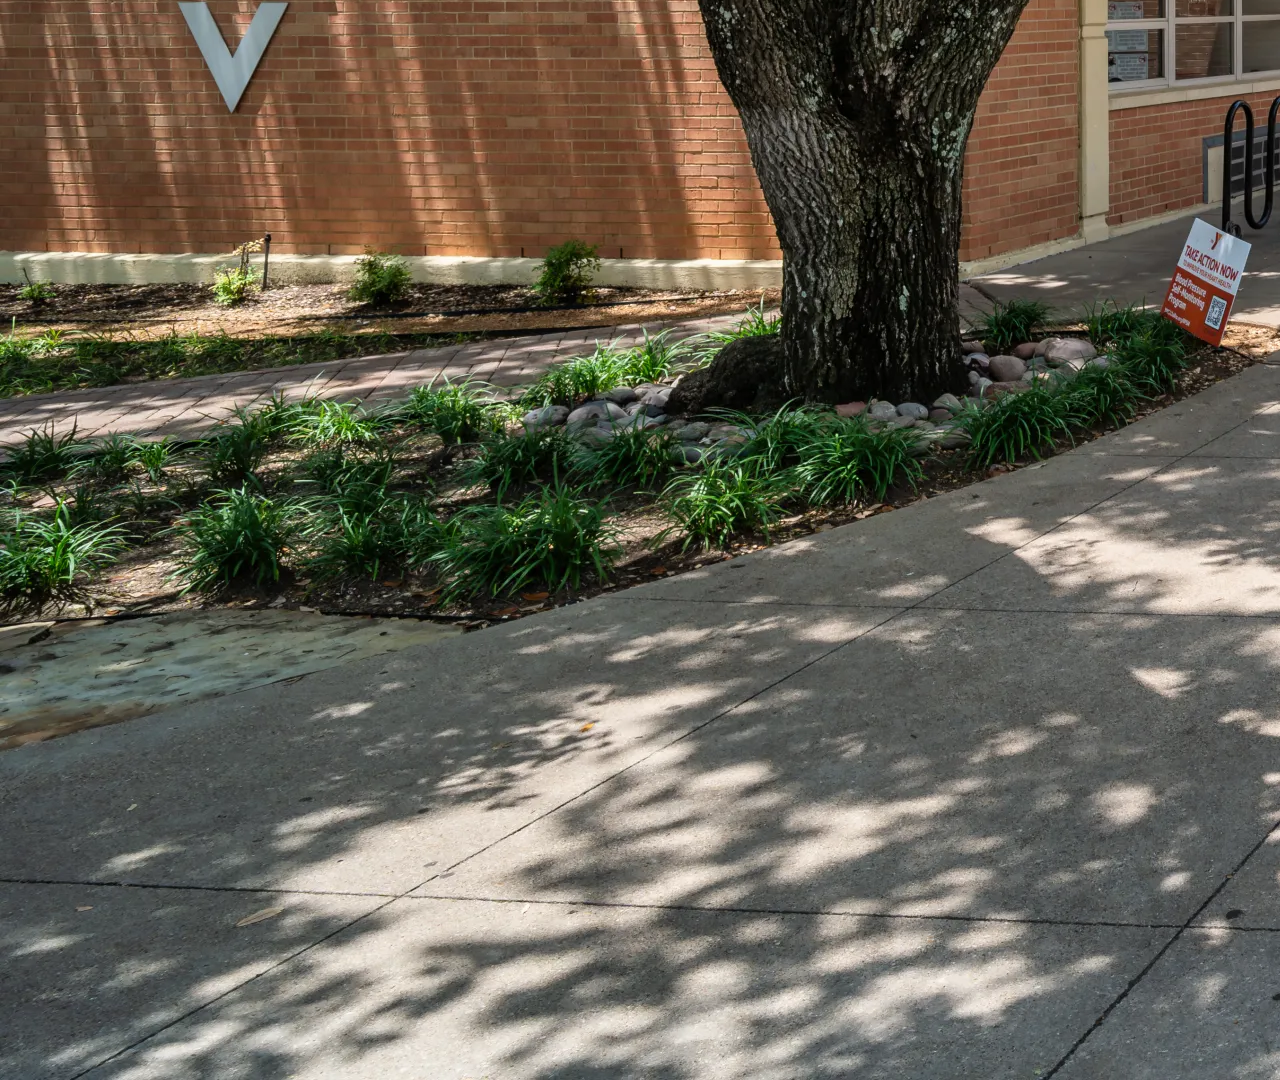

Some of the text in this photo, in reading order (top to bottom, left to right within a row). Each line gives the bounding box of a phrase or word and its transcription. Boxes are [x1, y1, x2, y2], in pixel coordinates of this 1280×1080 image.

[1185, 245, 1239, 281] TAKE ACTION NOW
[1175, 273, 1207, 298] Blood Pressure
[1167, 293, 1187, 310] Program
